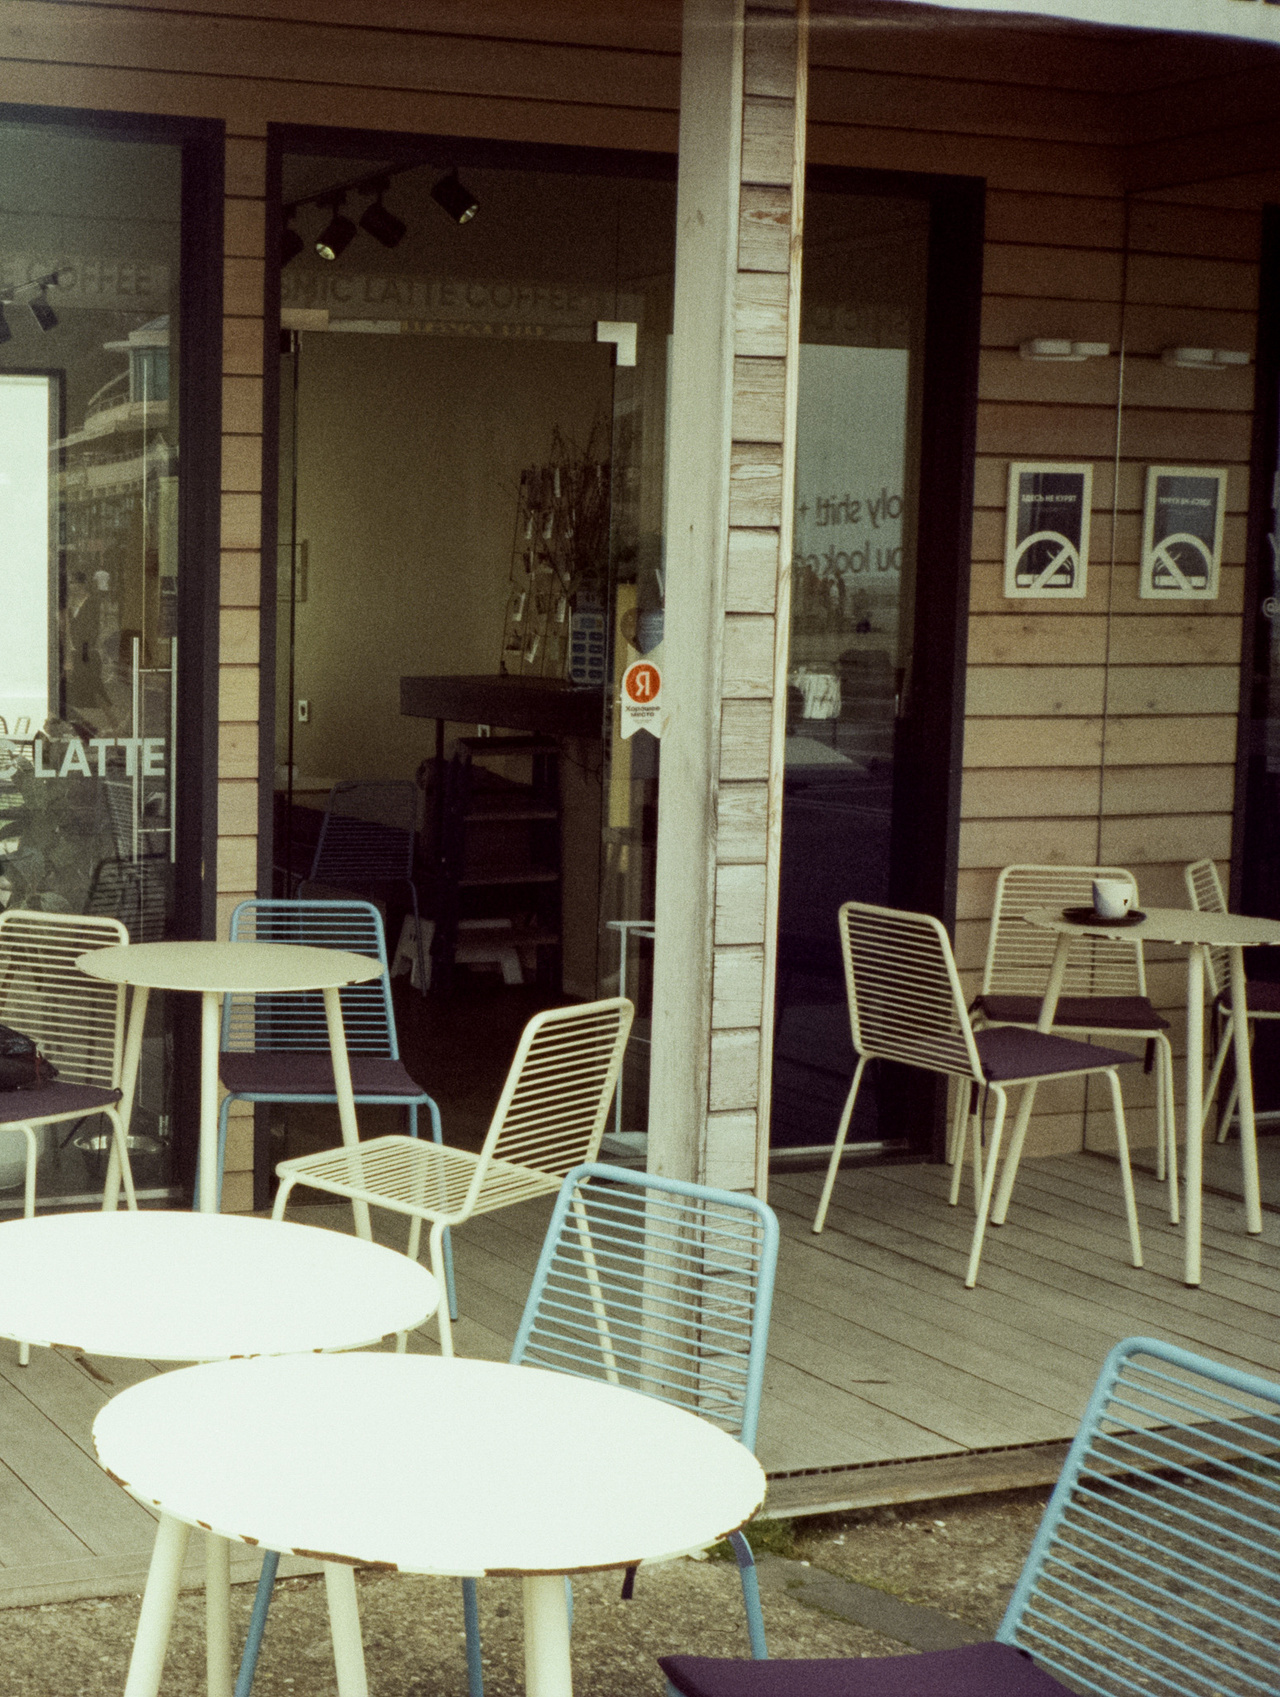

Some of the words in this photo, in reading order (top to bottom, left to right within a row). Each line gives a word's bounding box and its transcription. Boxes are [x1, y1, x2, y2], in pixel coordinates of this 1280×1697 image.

[363, 275, 458, 308] LATTE
[635, 670, 651, 697] Я
[33, 737, 167, 778] LATTE
